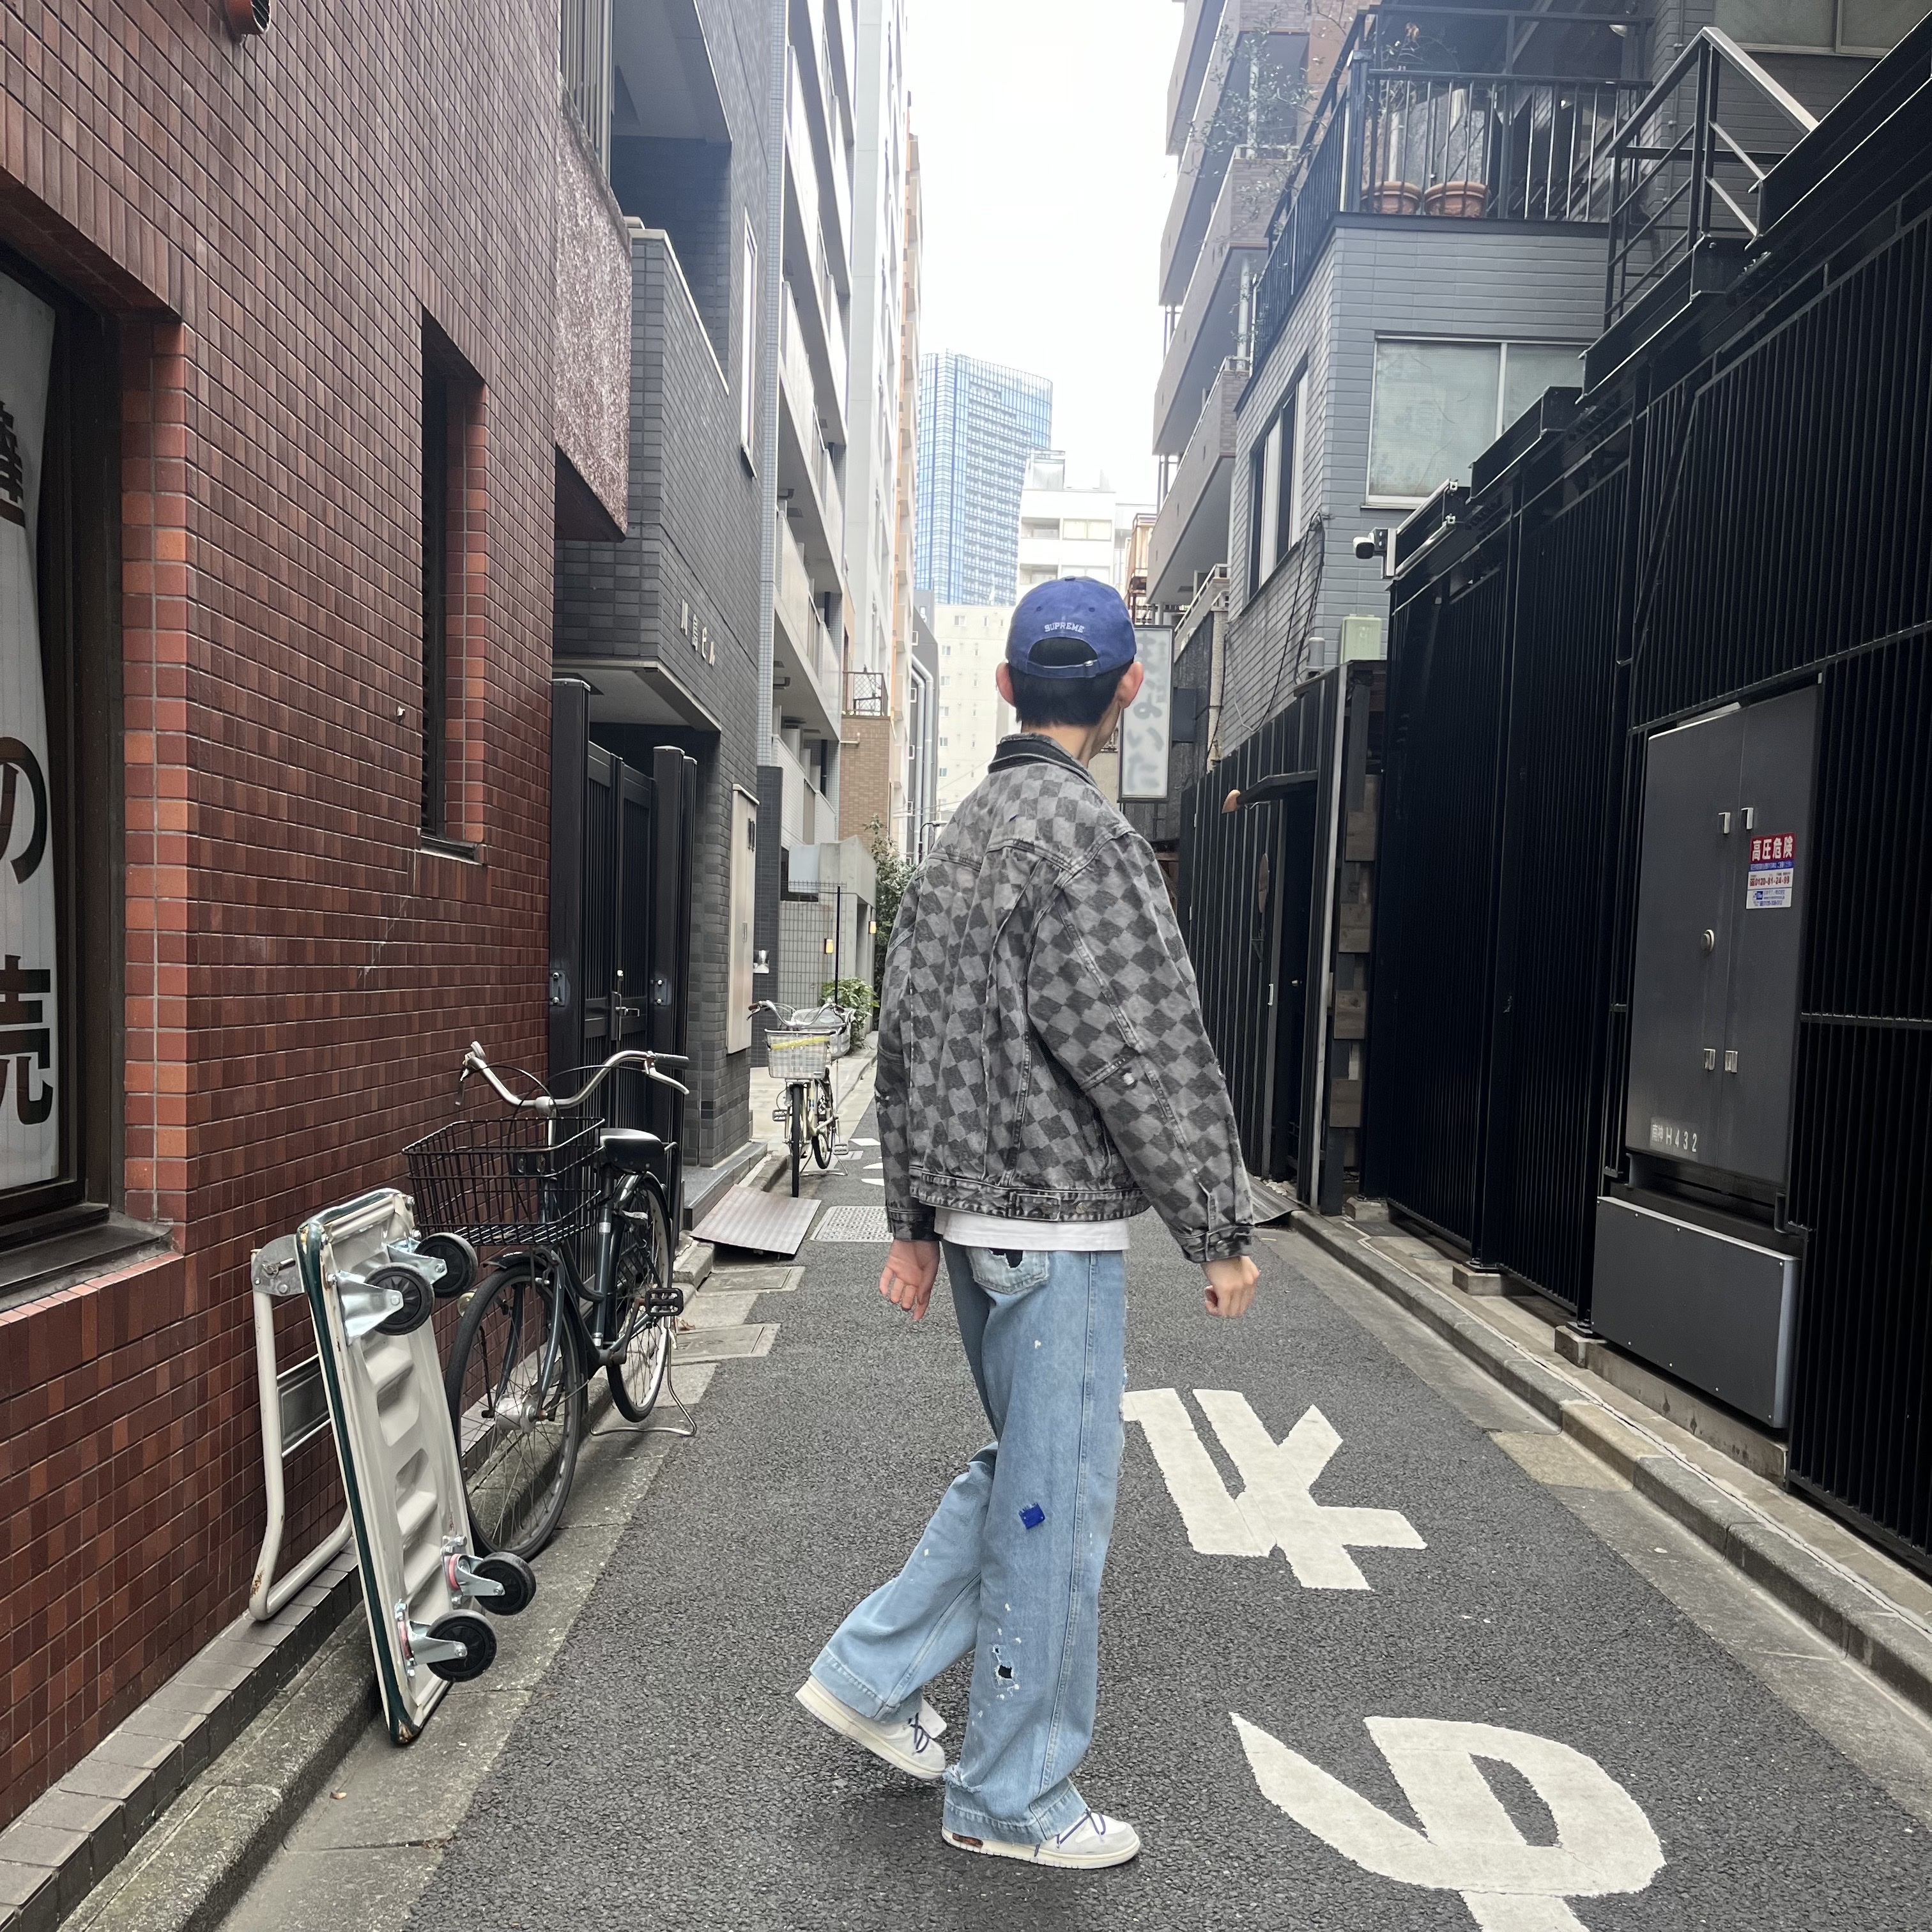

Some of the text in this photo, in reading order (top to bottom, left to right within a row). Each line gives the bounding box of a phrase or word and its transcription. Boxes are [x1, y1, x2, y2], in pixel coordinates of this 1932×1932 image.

[1044, 622, 1085, 633] SUPREME
[1752, 835, 1793, 862] 高圧危険
